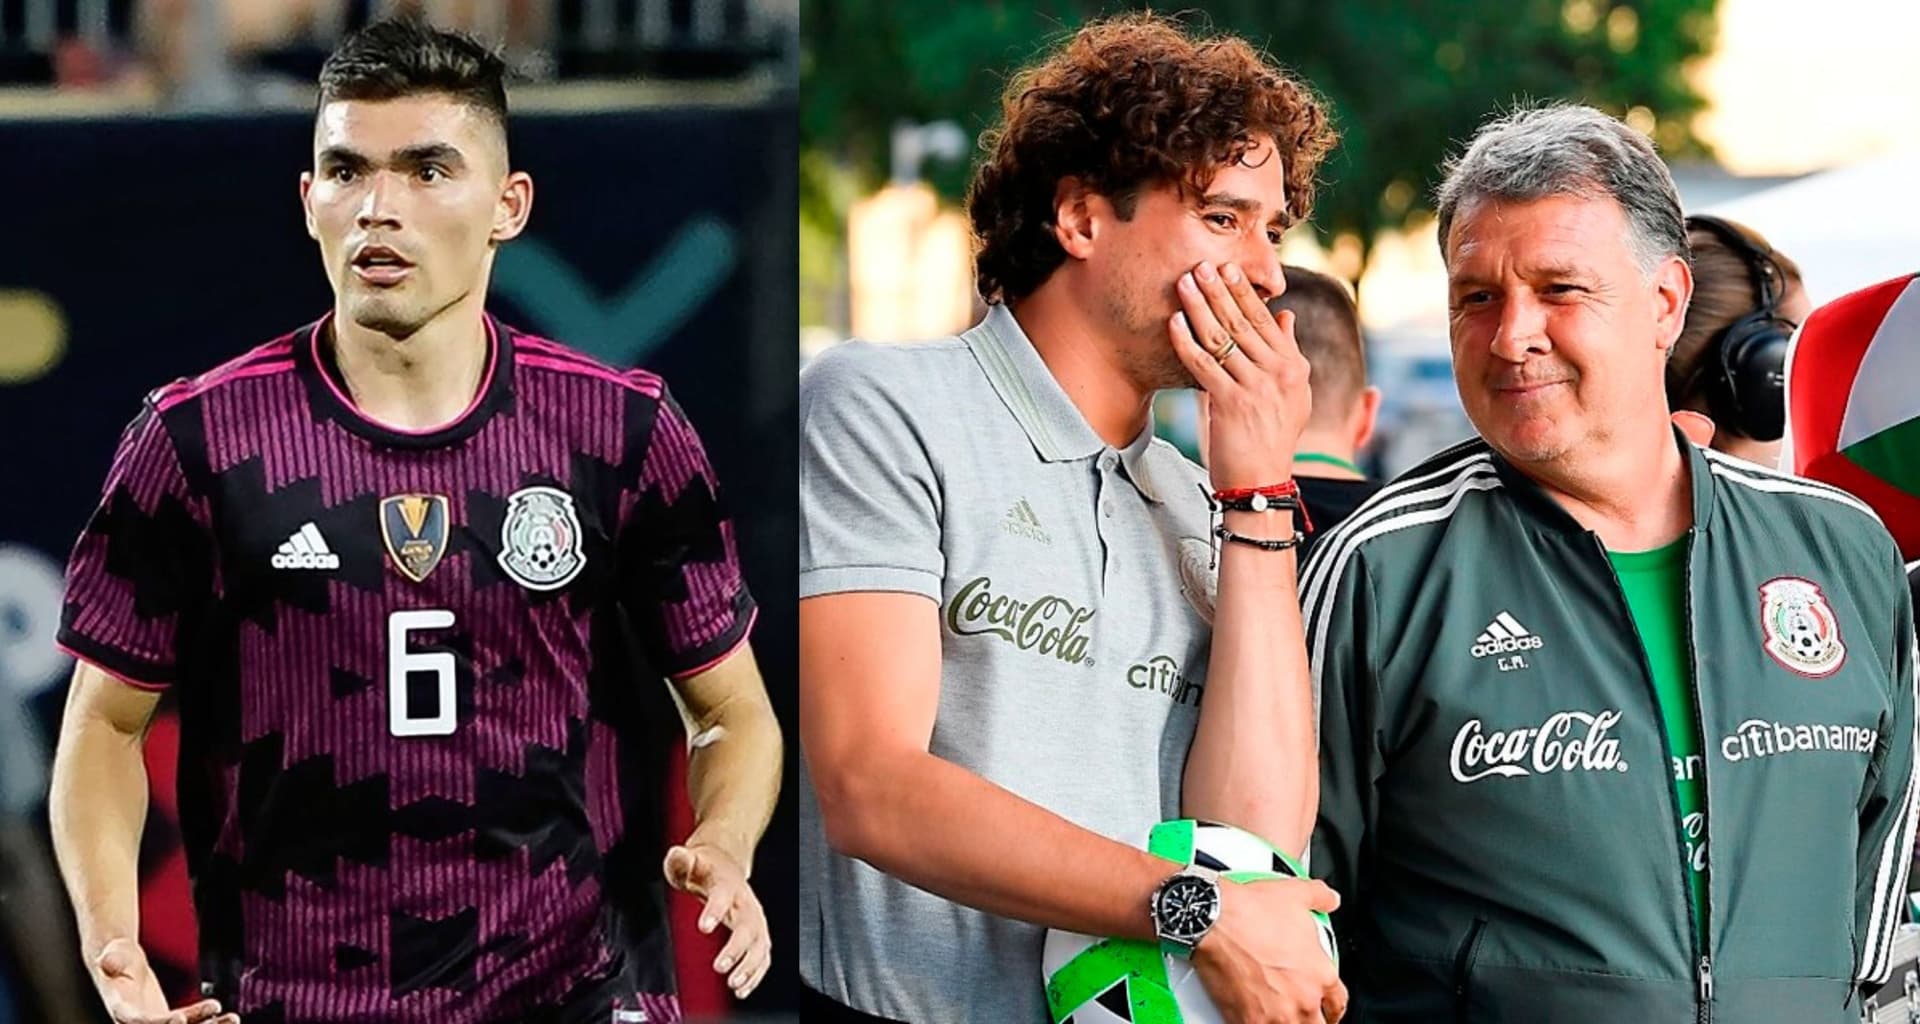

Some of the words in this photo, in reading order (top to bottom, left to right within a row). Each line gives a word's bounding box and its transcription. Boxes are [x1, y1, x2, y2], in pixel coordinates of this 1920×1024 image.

[271, 550, 339, 569] adidas
[948, 576, 1095, 664] Coca-Cola
[1470, 636, 1544, 658] adidas
[388, 610, 457, 737] 6
[1450, 710, 1623, 784] Coca-Cola
